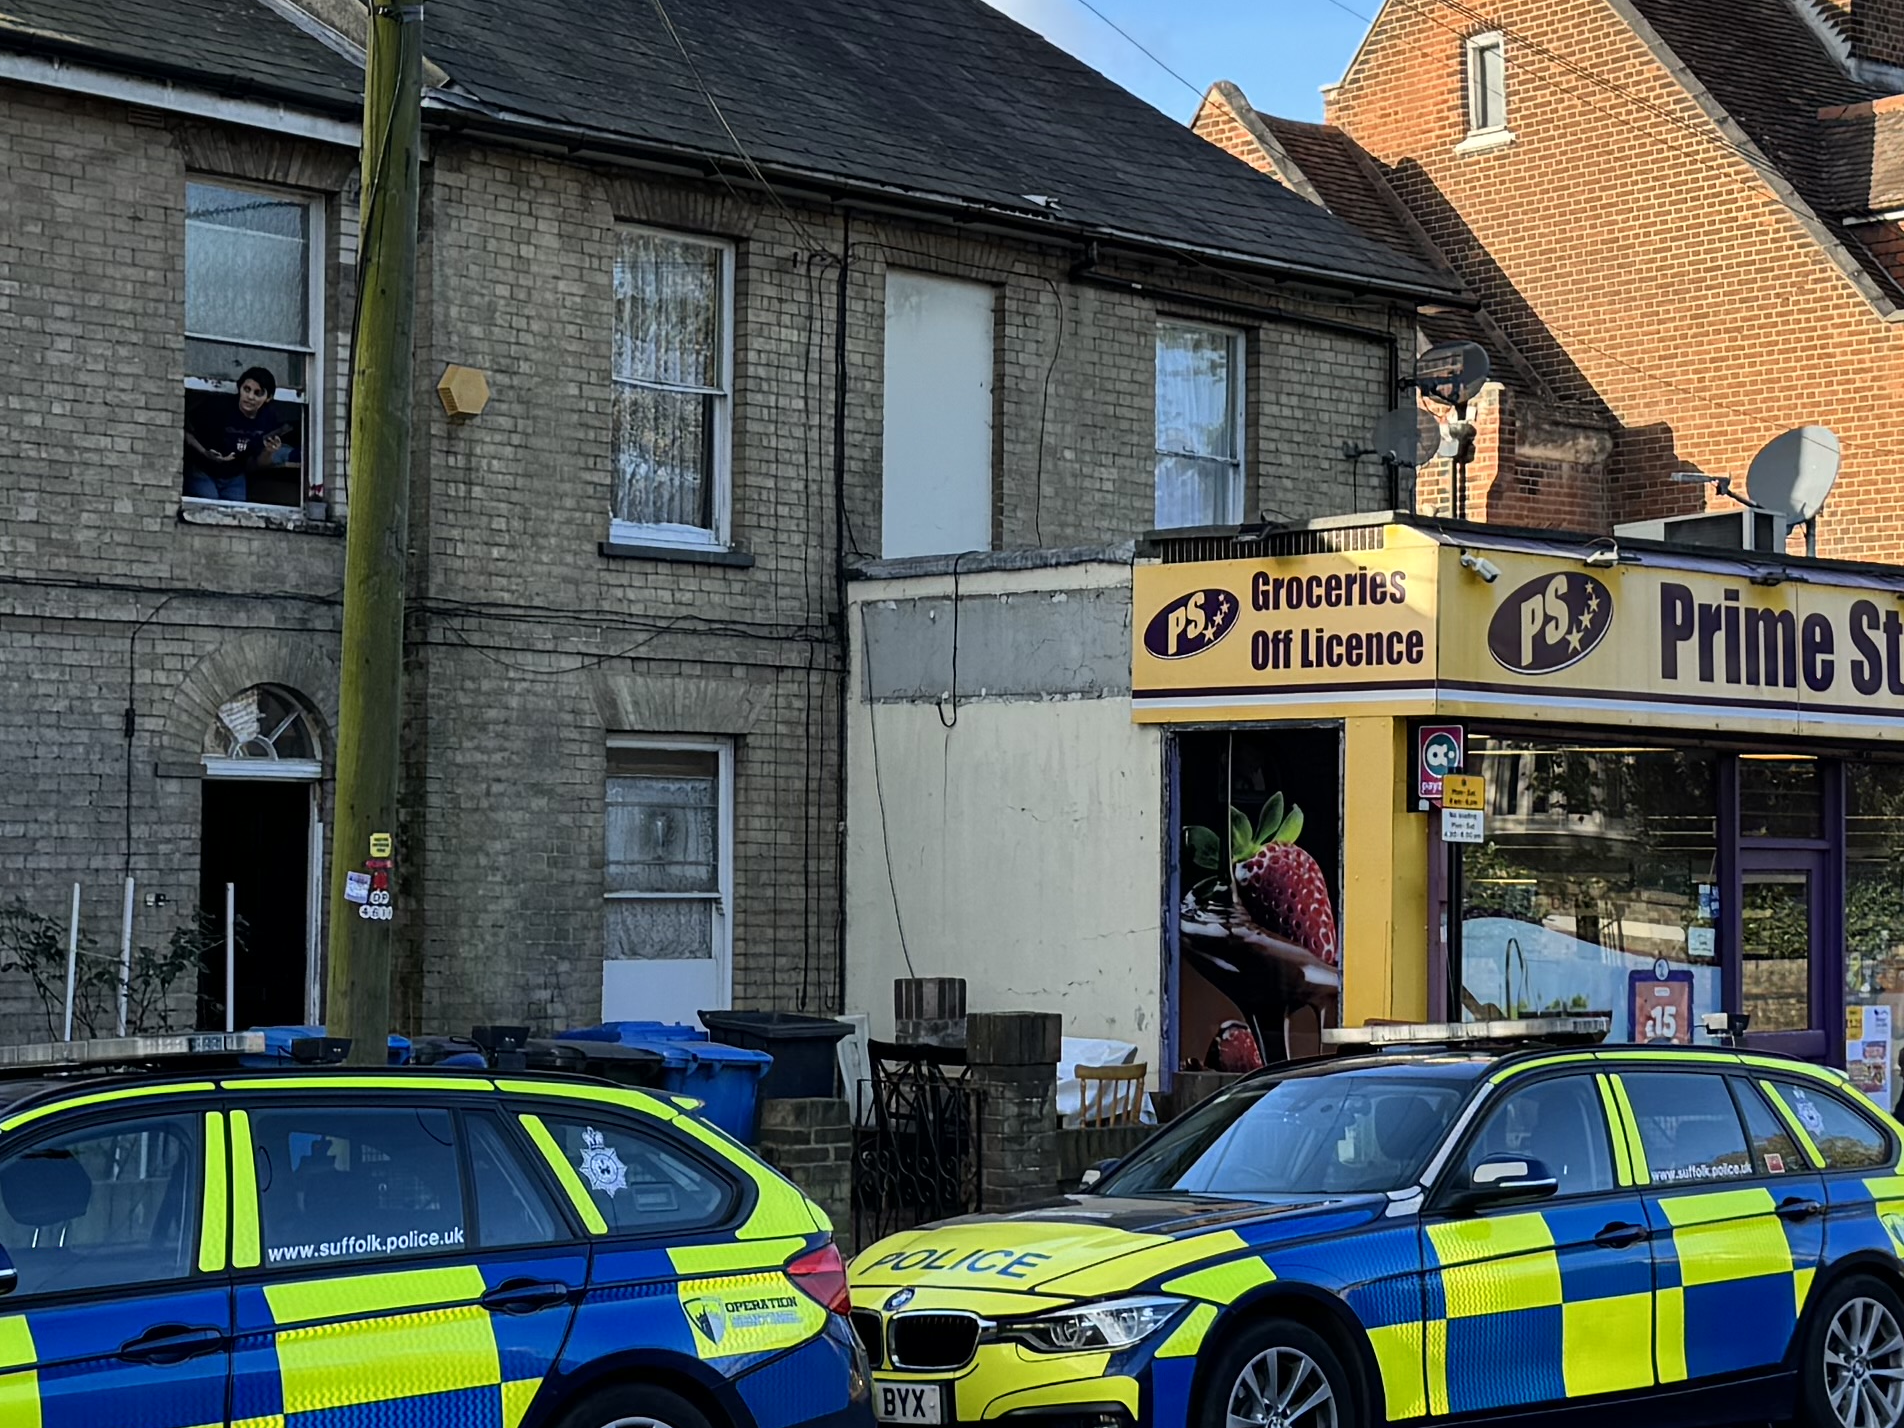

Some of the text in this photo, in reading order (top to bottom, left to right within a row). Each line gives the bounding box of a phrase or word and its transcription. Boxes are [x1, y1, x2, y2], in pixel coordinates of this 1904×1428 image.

[1252, 566, 1406, 612] Groceries
[1168, 591, 1205, 655] PS
[1521, 574, 1569, 667] PS
[1660, 581, 1835, 692] Prime
[1251, 628, 1424, 671] Off Licence
[268, 1226, 465, 1263] www.suffolk.police.uk
[858, 1248, 1053, 1279] POLICE
[725, 1296, 798, 1313] OPERATION
[882, 1387, 926, 1418] BYX
